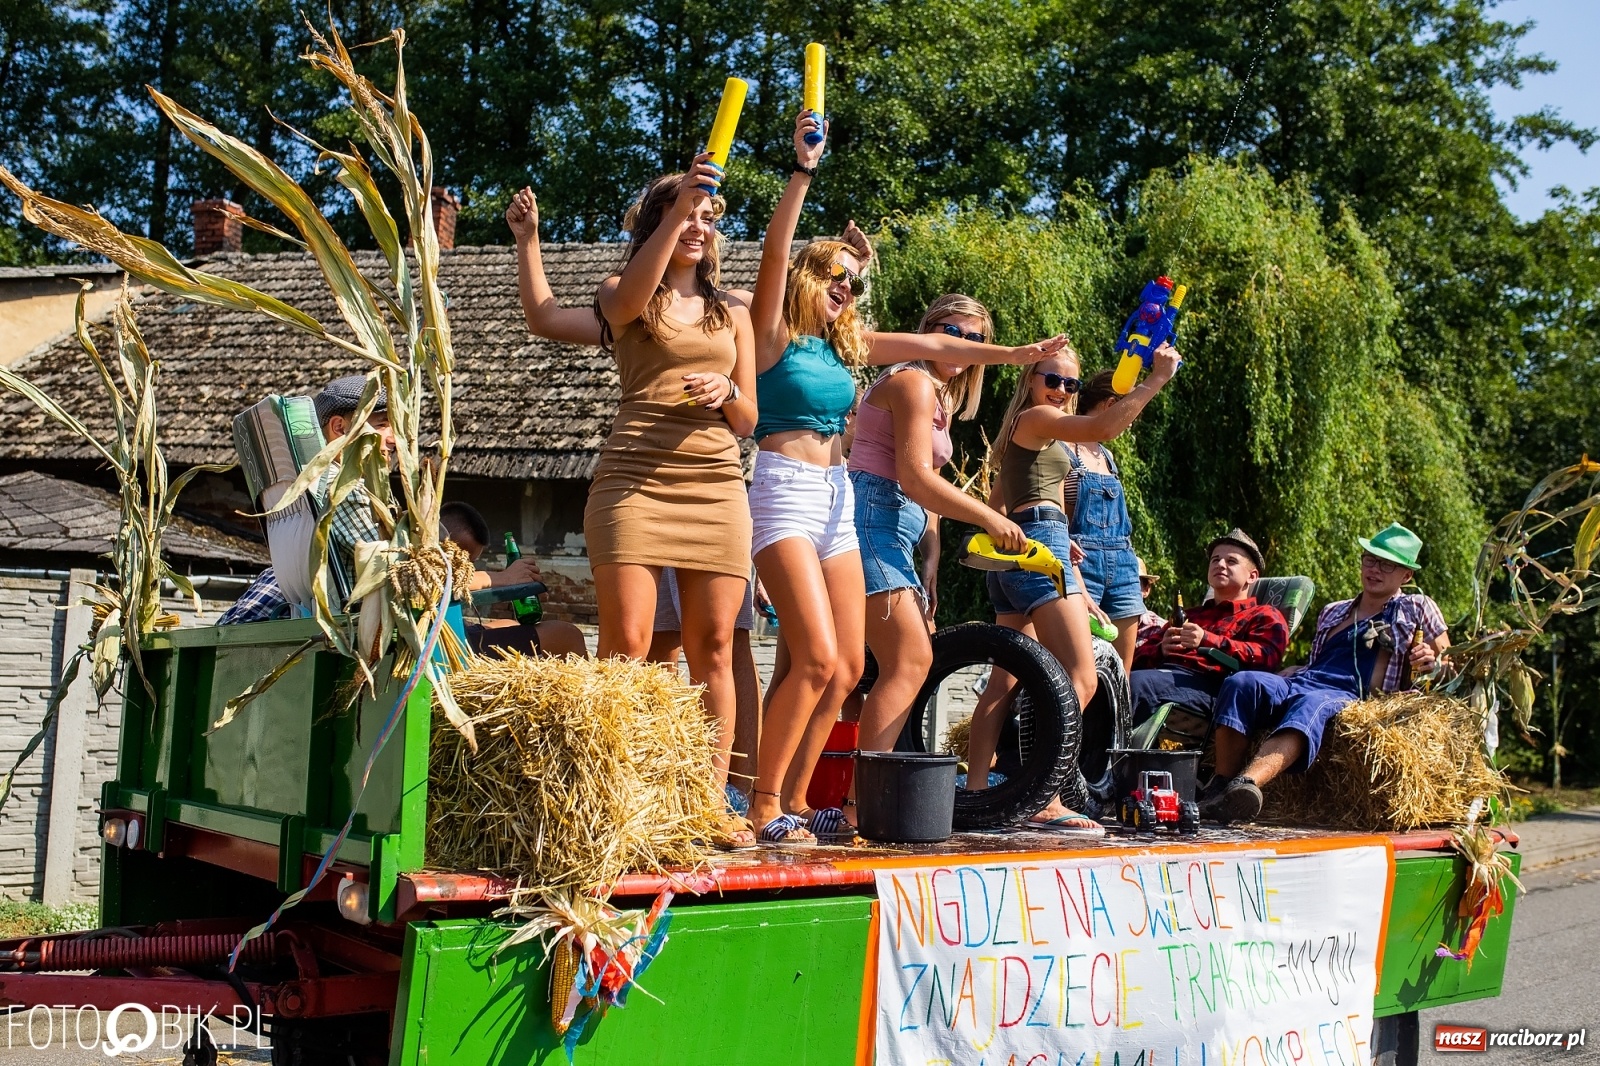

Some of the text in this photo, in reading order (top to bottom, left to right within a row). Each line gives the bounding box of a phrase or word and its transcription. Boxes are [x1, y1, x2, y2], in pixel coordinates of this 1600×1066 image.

[891, 866, 1049, 950] NIGDZIE
[1055, 867, 1115, 938] NA
[1236, 859, 1281, 923] NIE
[899, 931, 1357, 1051] ZNAJDZIECIE TRAKTOR-MYJNI
